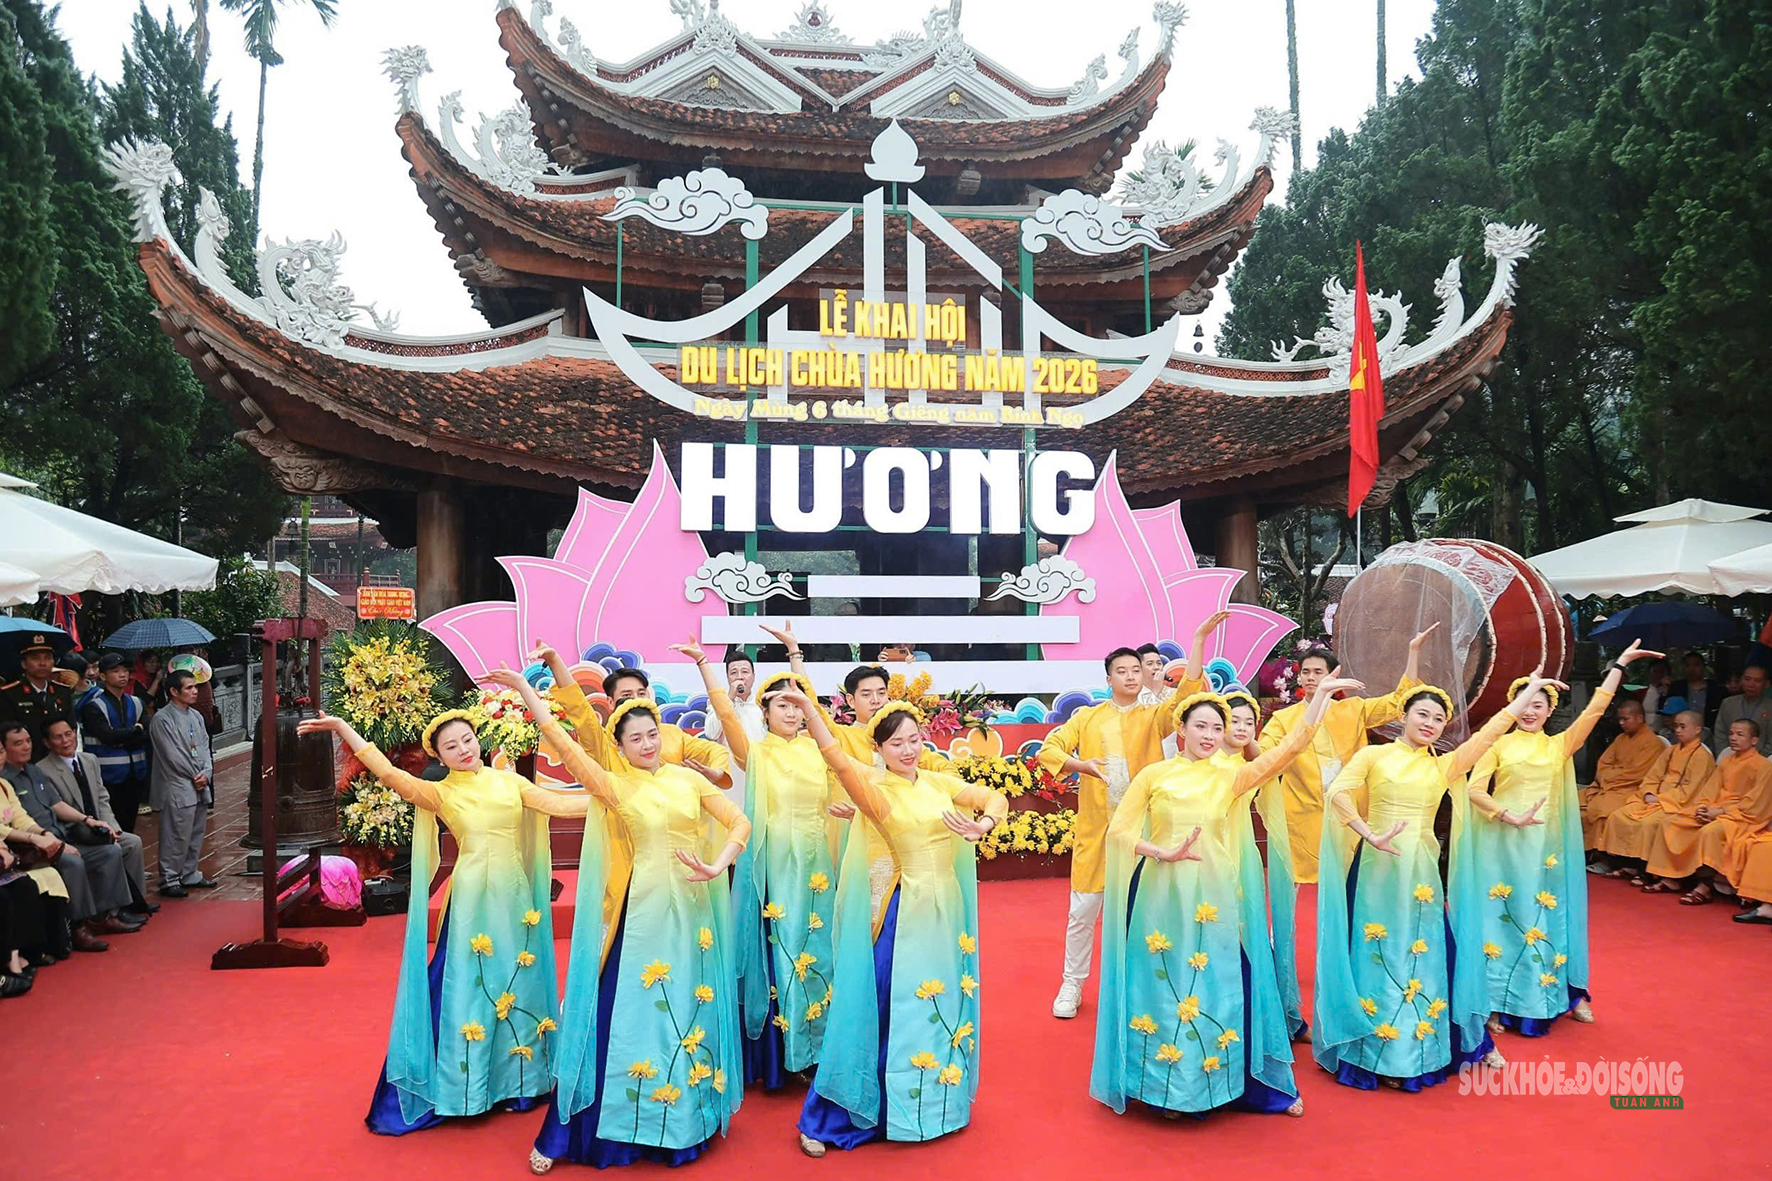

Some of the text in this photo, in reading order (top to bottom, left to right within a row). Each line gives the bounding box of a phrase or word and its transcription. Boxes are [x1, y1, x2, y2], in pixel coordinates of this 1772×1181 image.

[819, 288, 966, 348] LỄ KHAI HỘI
[681, 342, 1099, 395] DU LỊCH CHÙA HƯƠNG NĂM 2026
[813, 401, 828, 418] 6
[680, 441, 1096, 536] HƯƠNG
